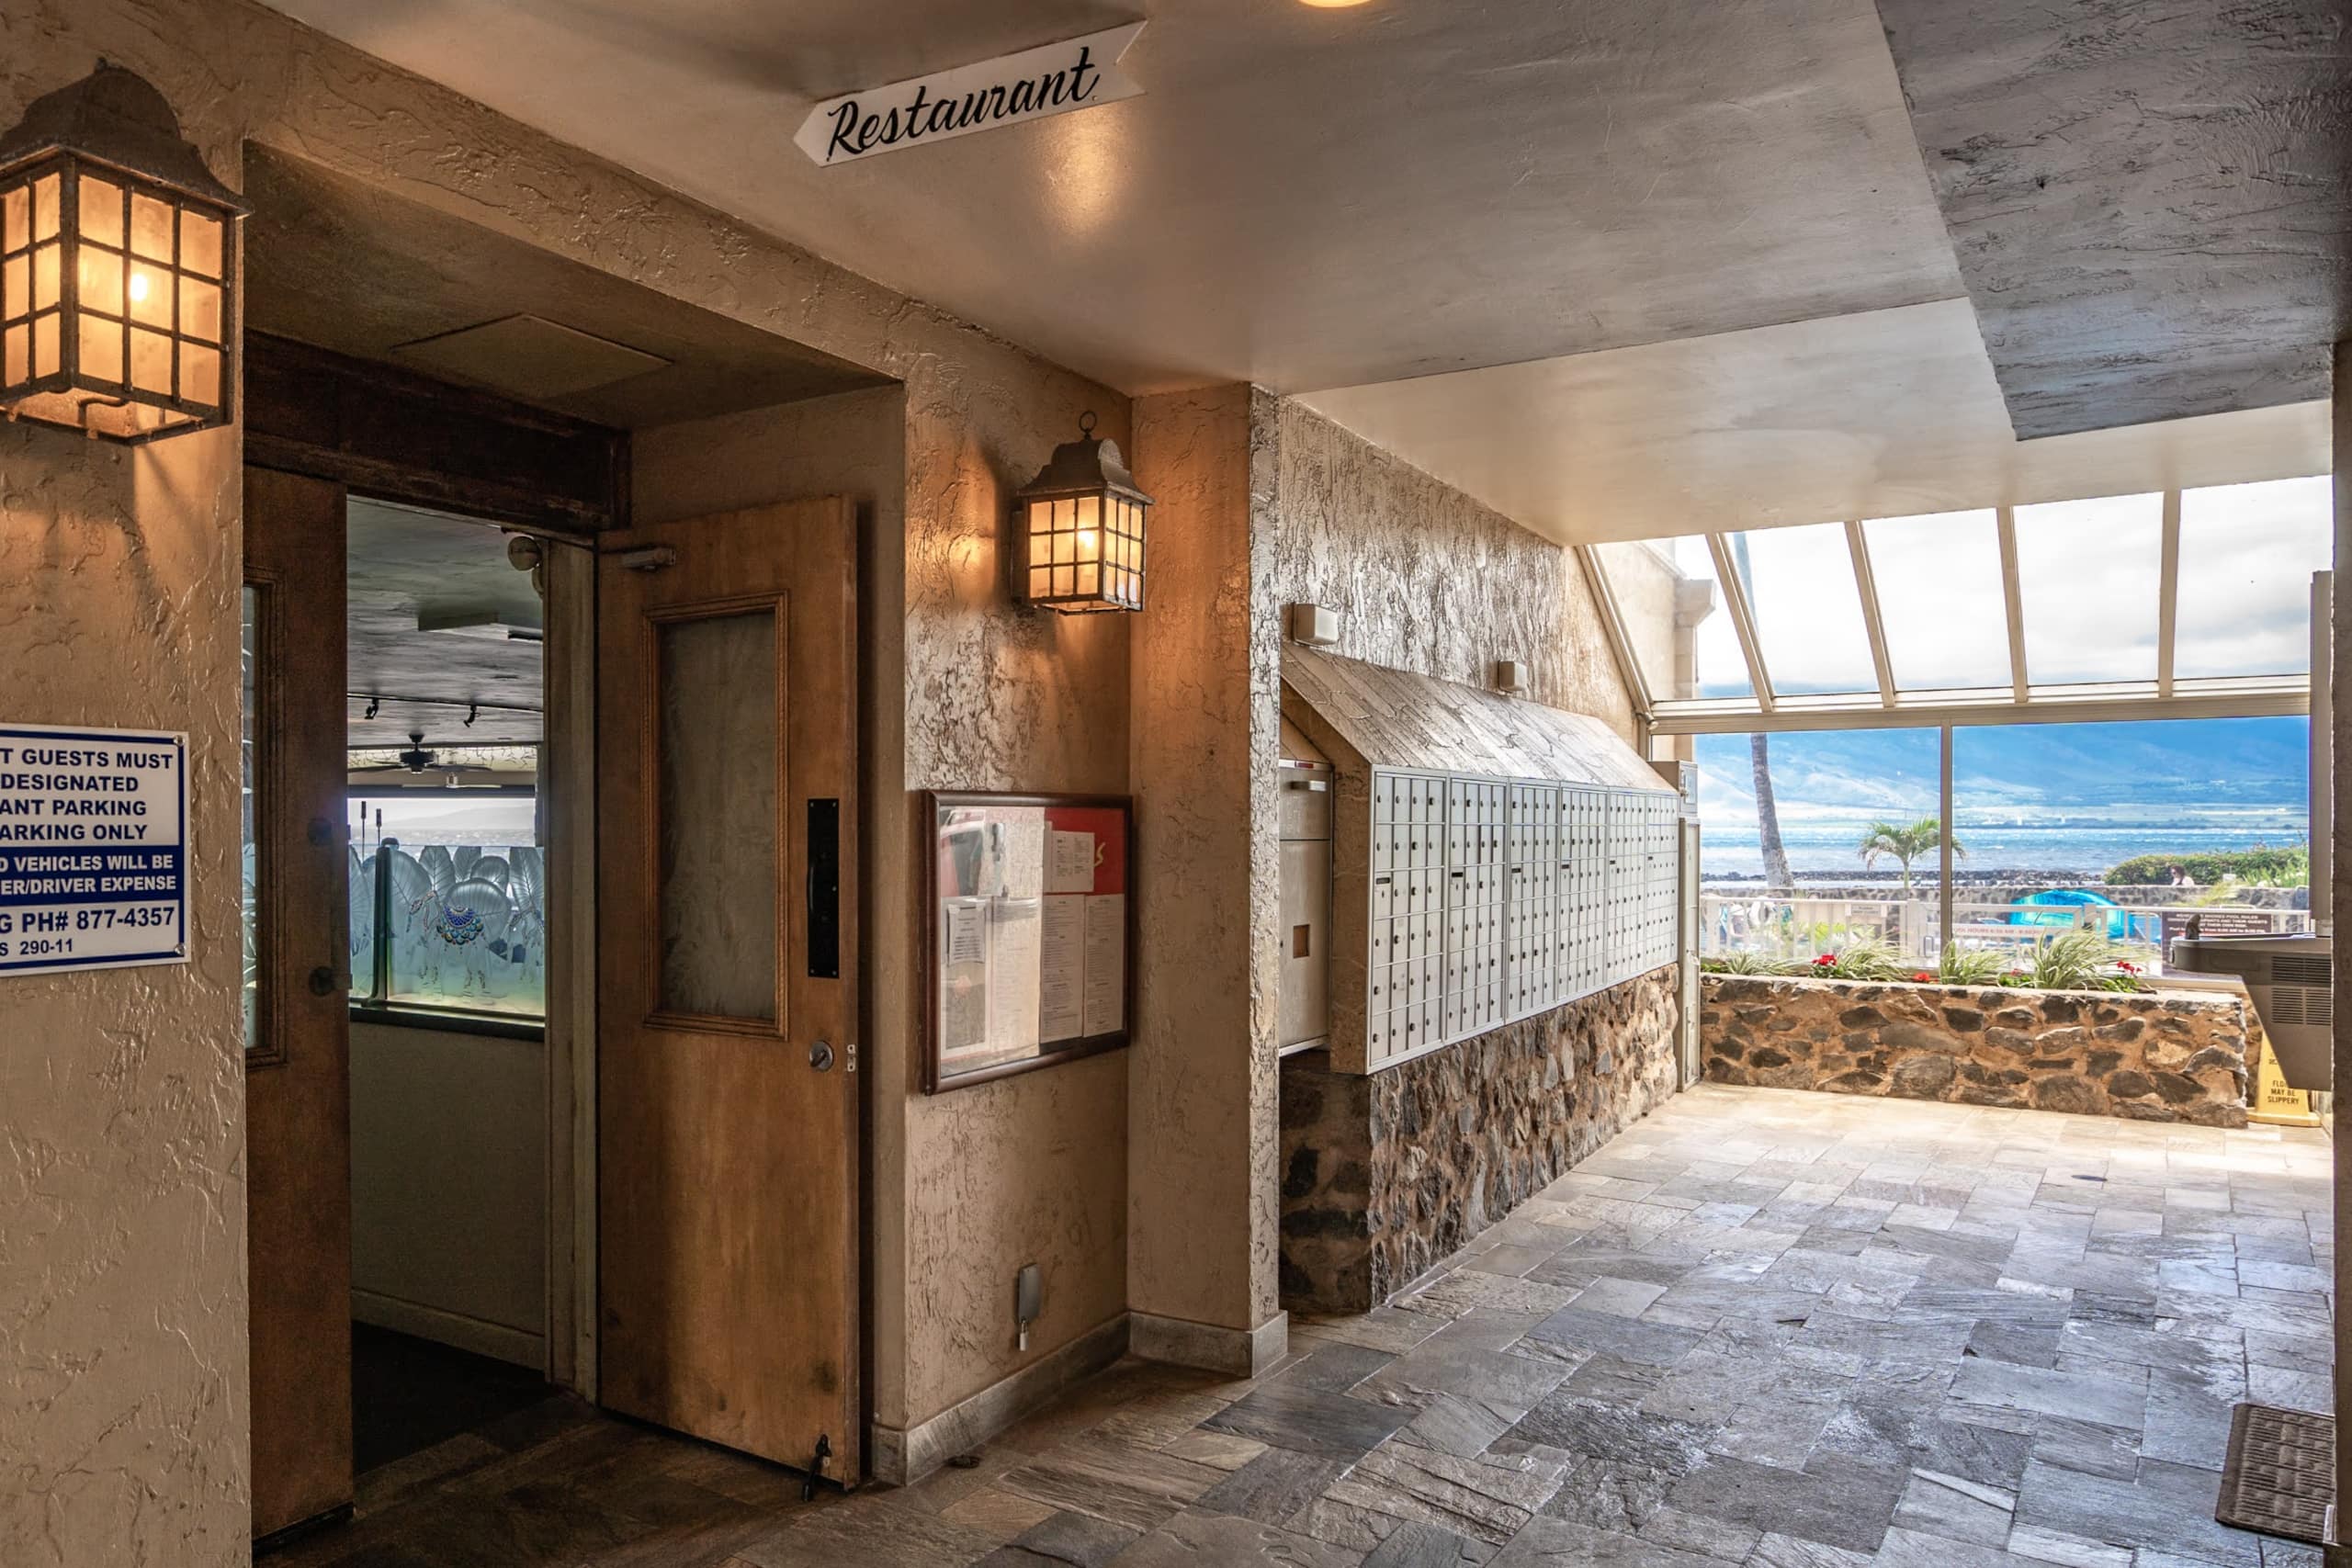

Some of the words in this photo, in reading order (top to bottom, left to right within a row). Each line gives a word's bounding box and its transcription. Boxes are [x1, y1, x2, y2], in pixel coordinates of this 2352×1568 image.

[827, 47, 1102, 162] Restaurant
[22, 749, 109, 767] GUESTS
[117, 752, 173, 769] MUST
[1, 773, 139, 792] DESIGNATED
[52, 800, 147, 816] PARKING
[93, 824, 147, 840] ONLY
[14, 855, 103, 872] VEHICLES
[107, 854, 147, 870] WILL
[152, 854, 174, 869] BE
[101, 875, 176, 892] EXPENSE
[22, 910, 68, 933] PH#
[76, 907, 175, 930] 877-4357
[19, 938, 74, 955] 290-11
[2267, 1096, 2300, 1104] SLIPPERY
